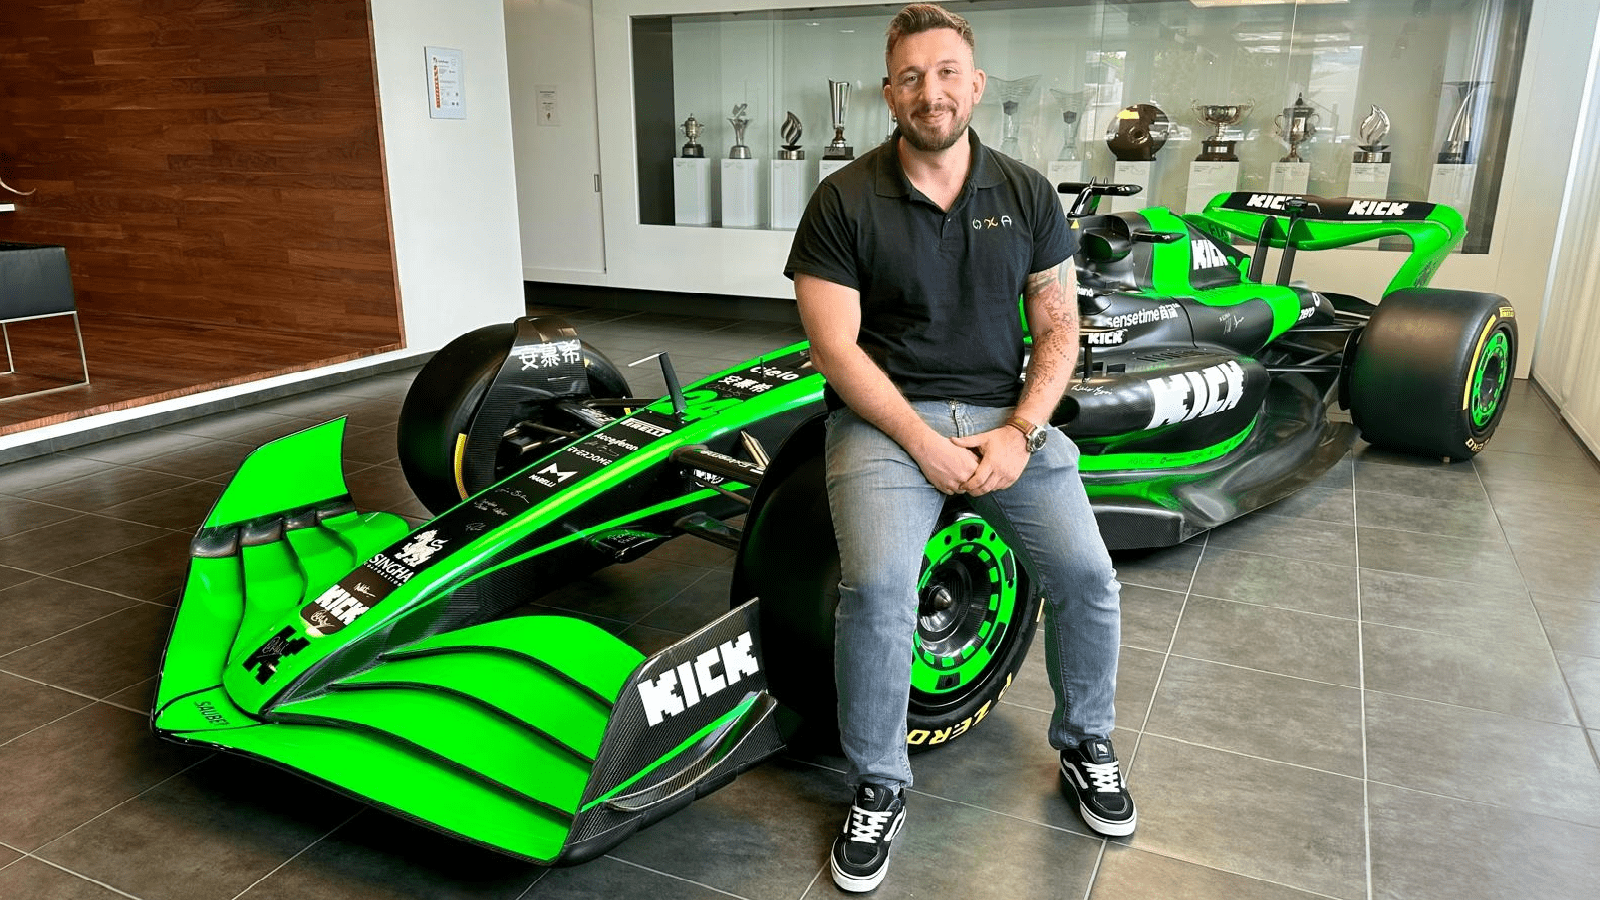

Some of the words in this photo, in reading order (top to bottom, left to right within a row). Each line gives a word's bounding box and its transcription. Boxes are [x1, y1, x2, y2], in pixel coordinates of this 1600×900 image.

[1348, 200, 1409, 216] KICK
[1107, 308, 1160, 328] sensetime
[1087, 328, 1129, 345] KICK
[1144, 360, 1244, 430] KICK
[620, 417, 673, 438] PIRELLI
[369, 553, 415, 583] SINGHA
[314, 584, 370, 626] KICK
[636, 630, 761, 728] KICK
[906, 699, 992, 746] ZERO
